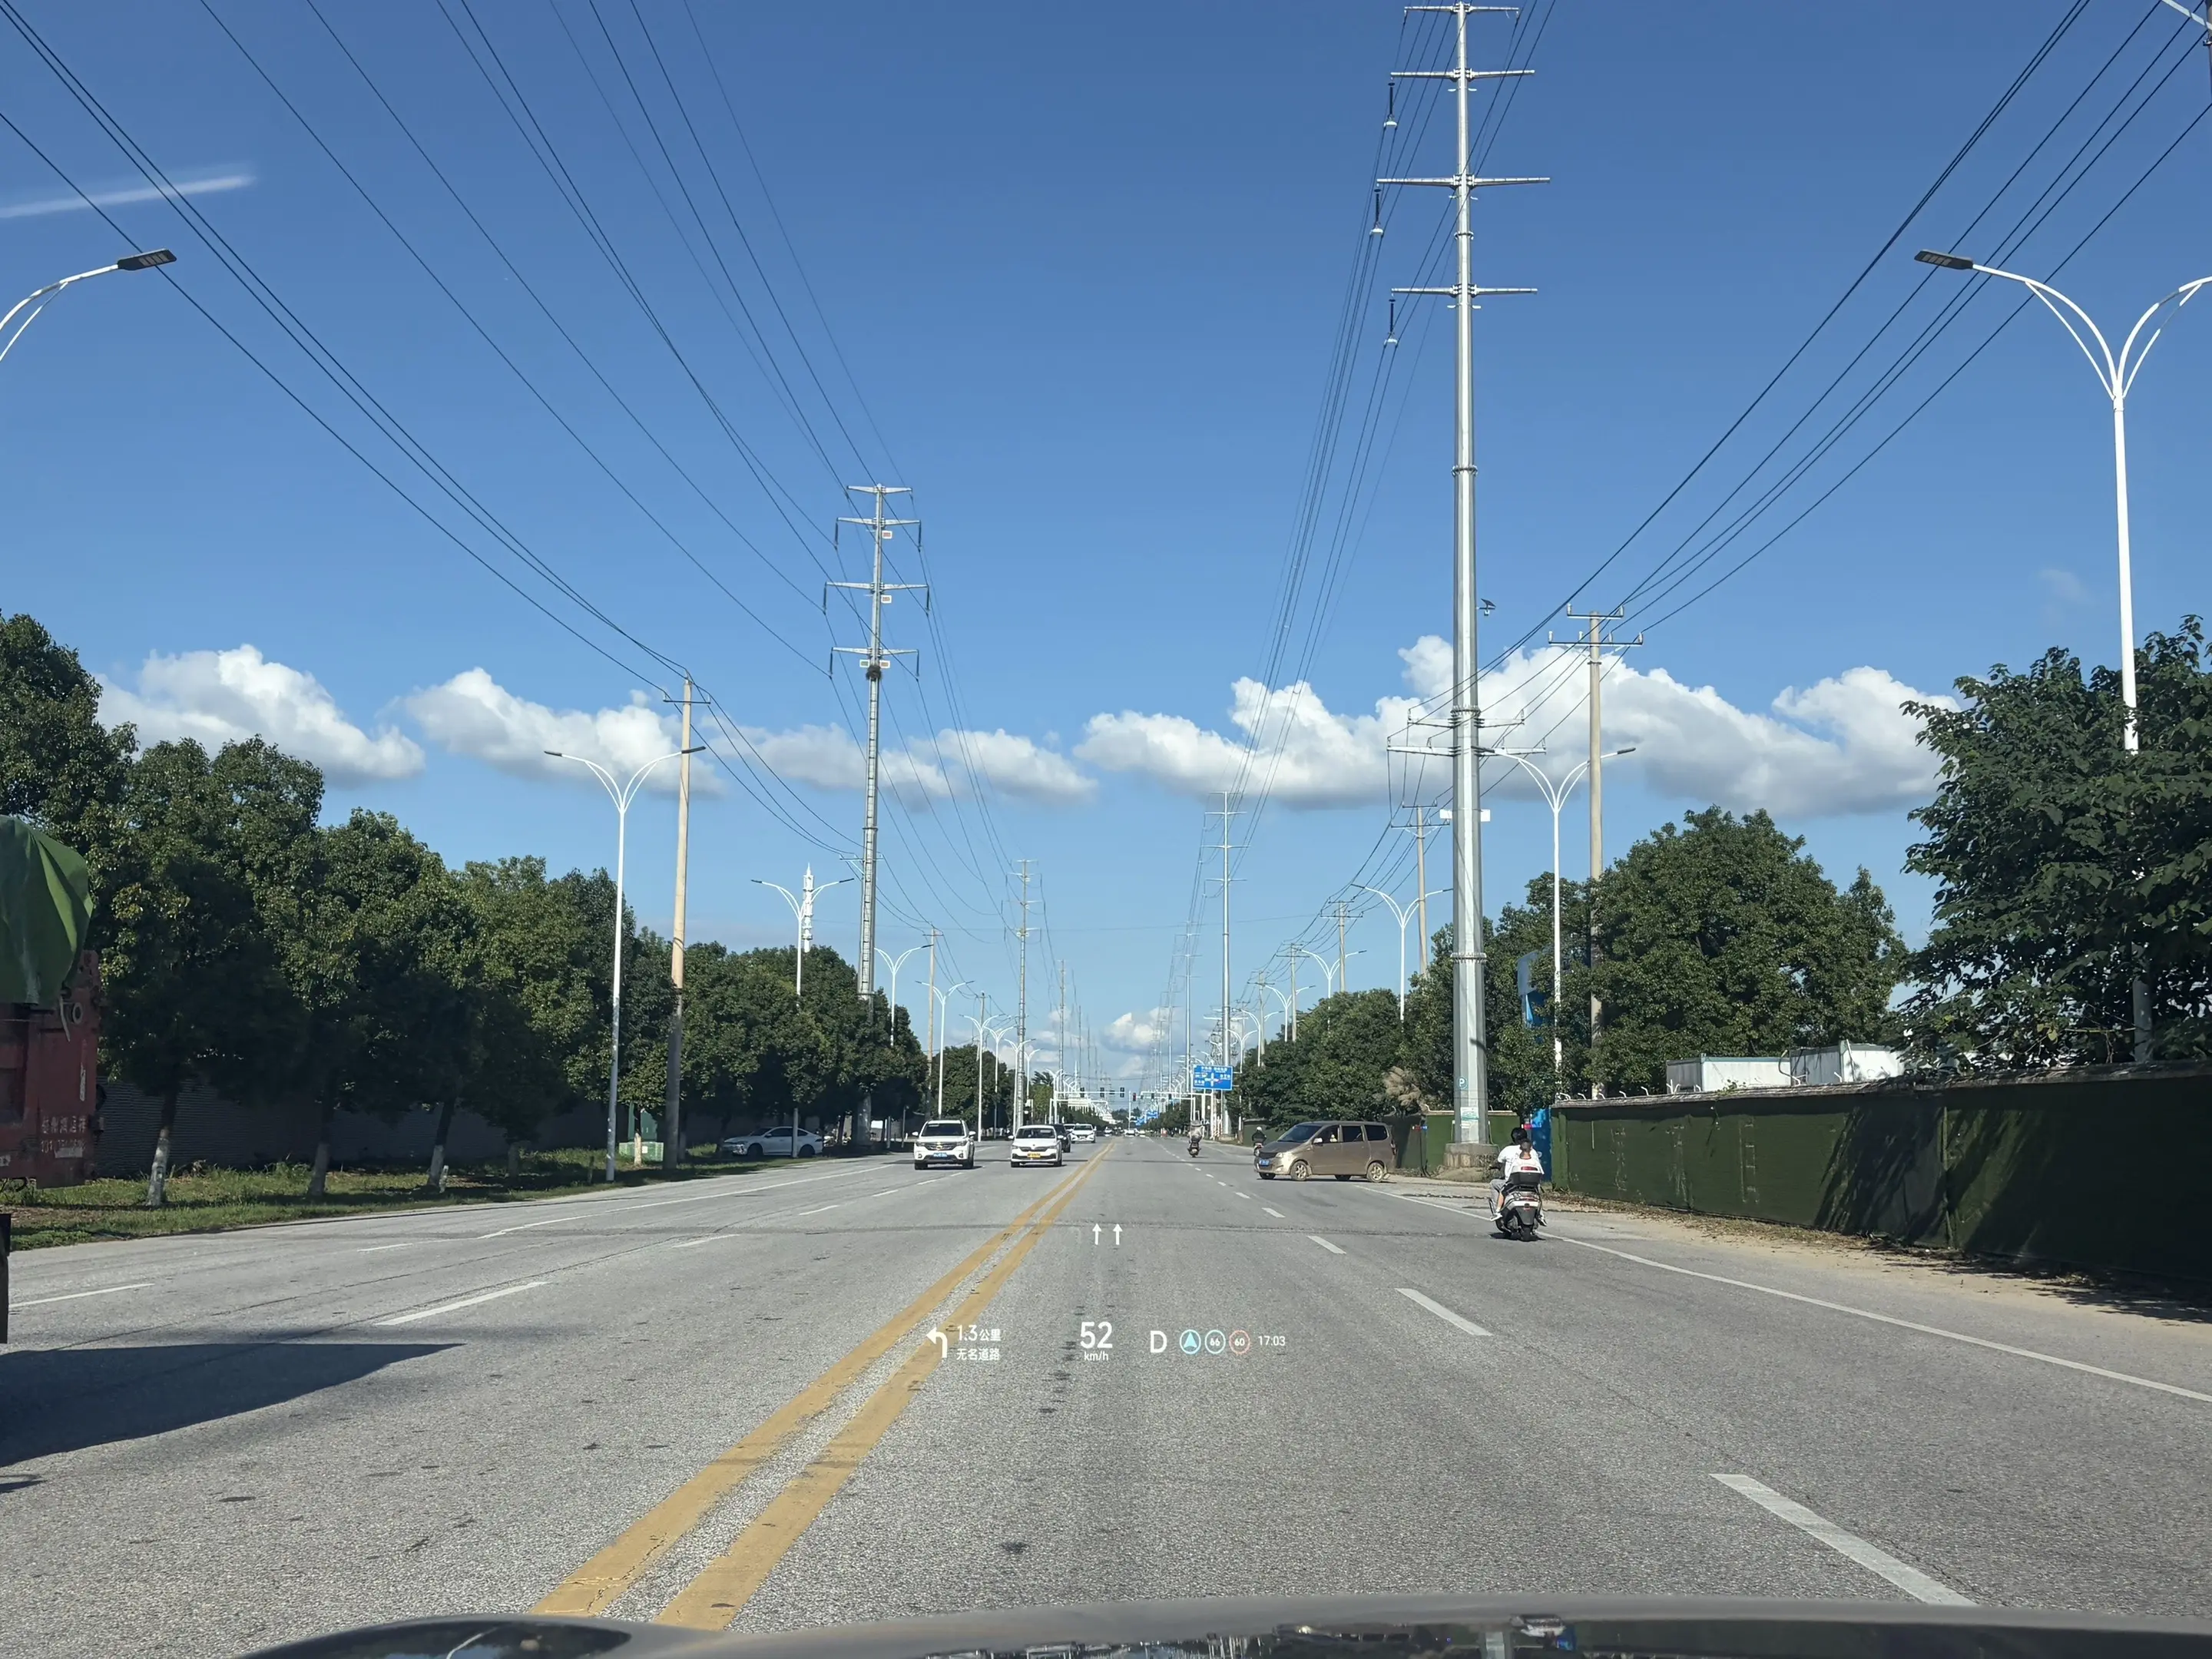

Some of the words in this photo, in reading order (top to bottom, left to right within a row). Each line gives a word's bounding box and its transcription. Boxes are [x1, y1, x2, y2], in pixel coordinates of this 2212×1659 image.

[1080, 1321, 1113, 1349] 52
[1258, 1336, 1286, 1346] 17:03
[1150, 1330, 1167, 1353] D
[1234, 1337, 1245, 1346] 60
[956, 1348, 1001, 1361] 无名道路
[1084, 1350, 1109, 1362] km/h
